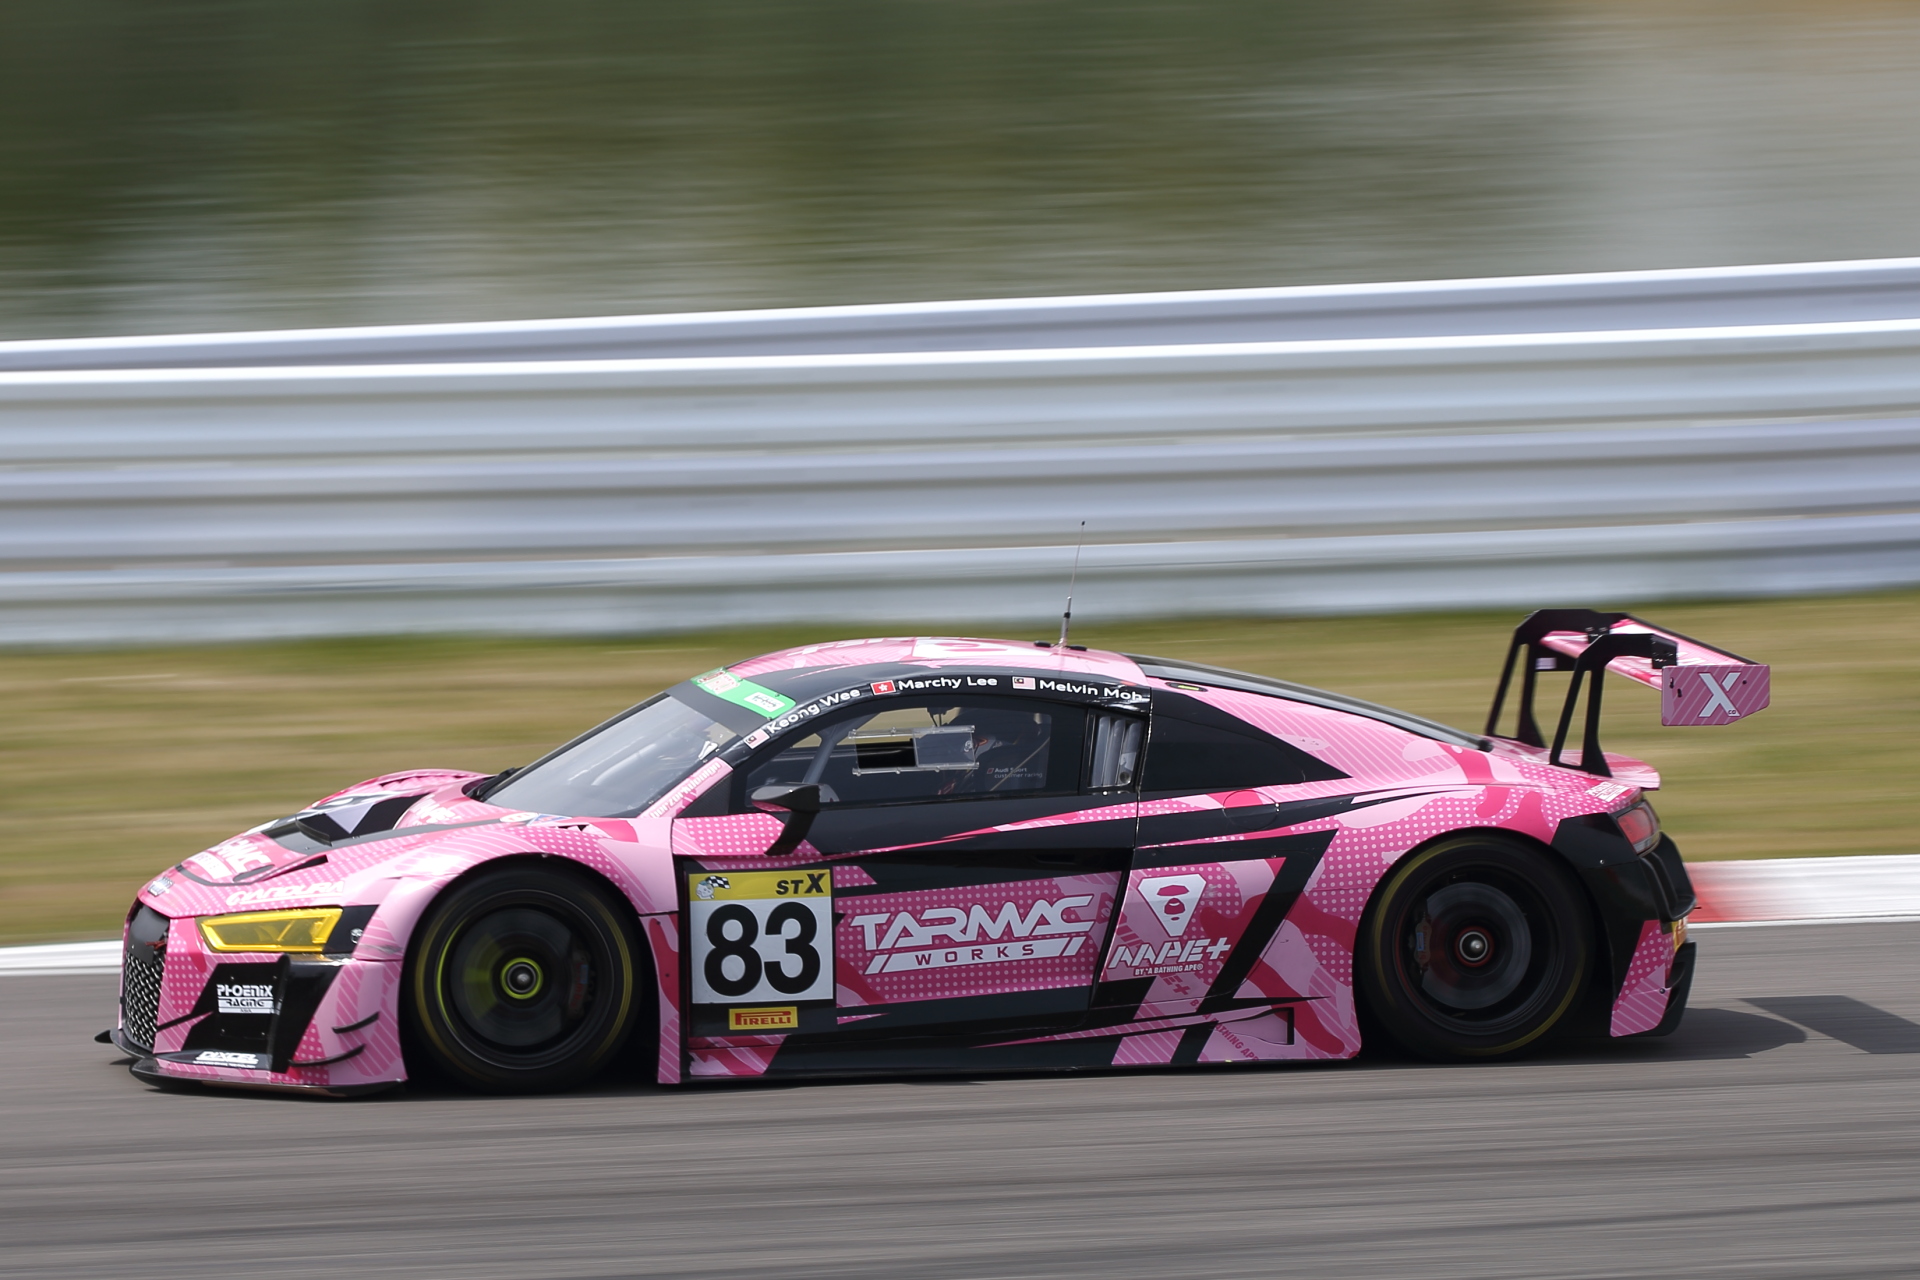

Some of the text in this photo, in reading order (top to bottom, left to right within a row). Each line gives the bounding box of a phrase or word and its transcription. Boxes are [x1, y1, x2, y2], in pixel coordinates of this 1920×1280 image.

[898, 675, 998, 691] Marchy Lee
[1039, 680, 1143, 702] Melvin Moh
[1698, 672, 1741, 717] X
[767, 689, 861, 734] Keong Wee
[775, 873, 826, 896] STX
[850, 895, 1096, 951] TARMAC
[703, 901, 821, 997] 83
[914, 943, 1036, 966] WORKS
[1134, 967, 1144, 976] BY
[1153, 965, 1183, 974] BATHING
[734, 1010, 792, 1026] PIRELLI
